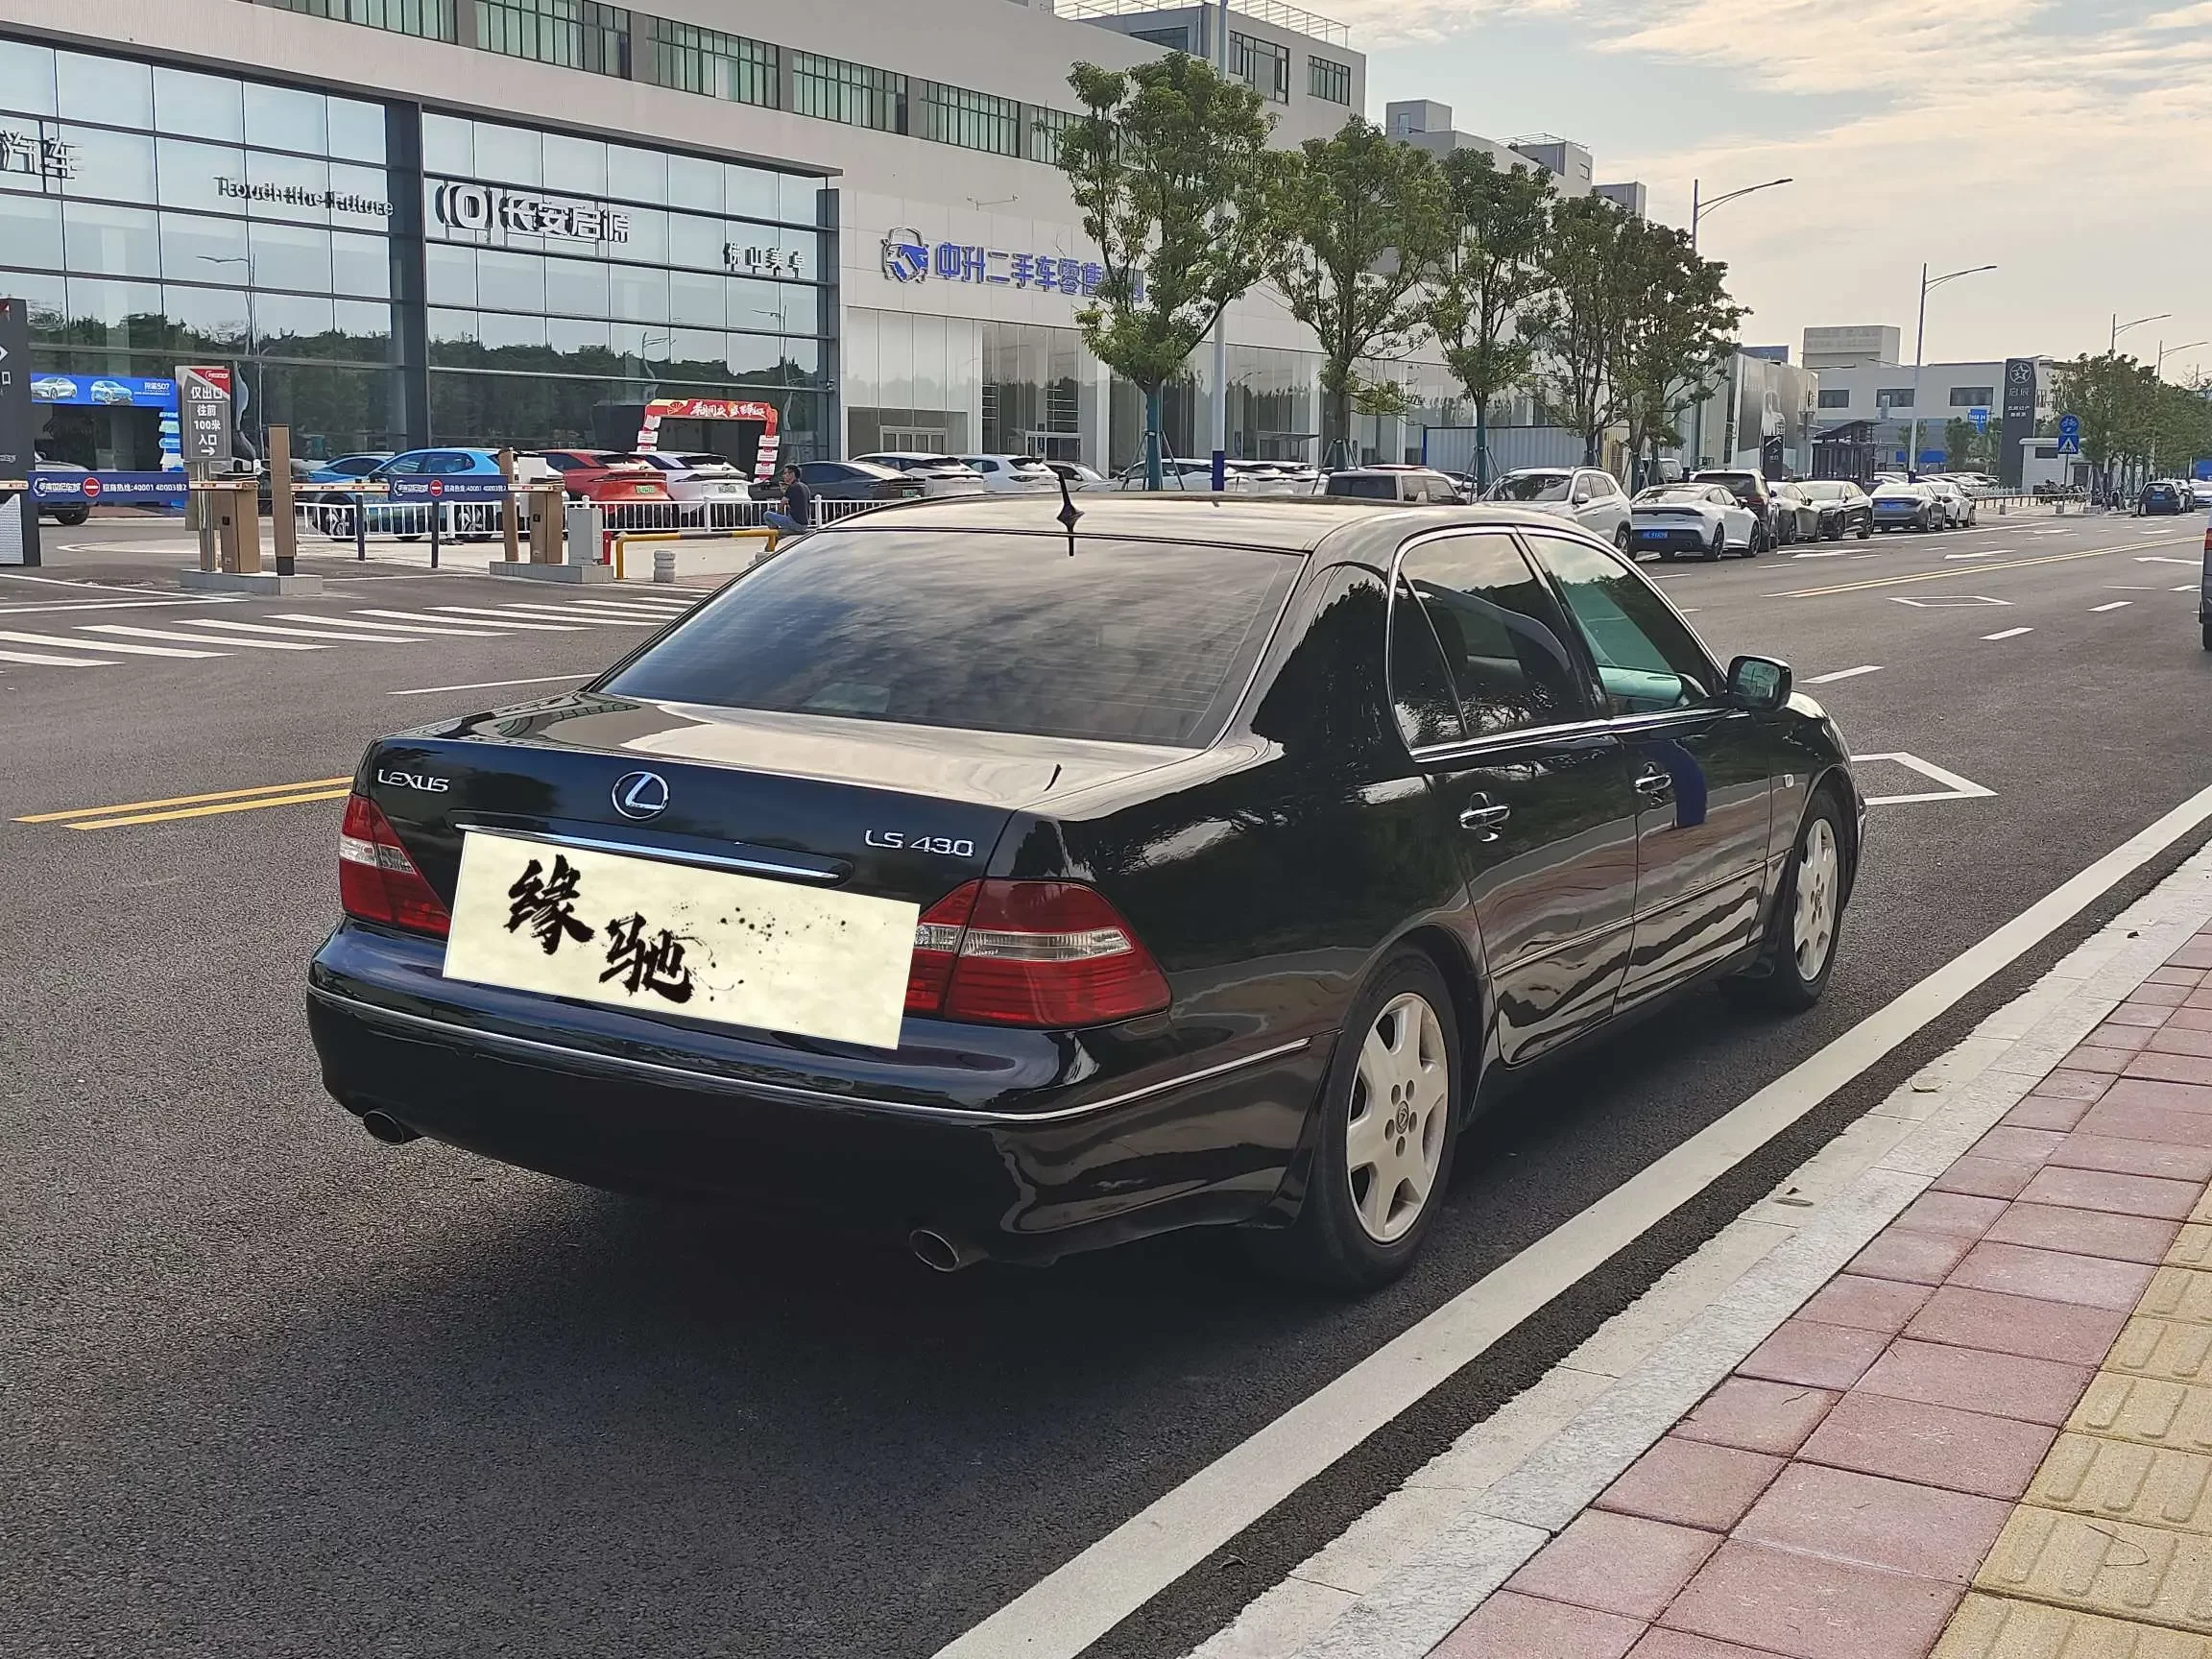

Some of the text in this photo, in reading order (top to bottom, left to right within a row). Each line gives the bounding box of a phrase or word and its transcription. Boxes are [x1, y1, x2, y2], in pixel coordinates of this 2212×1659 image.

[502, 196, 631, 243] 长安启源
[936, 242, 1144, 303] 中升二手车零售
[191, 386, 223, 399] 仅出口
[197, 404, 217, 417] 往前
[194, 419, 221, 430] 100米
[198, 434, 218, 445] 入口
[377, 768, 451, 793] LEXUS
[864, 830, 974, 857] LS 430
